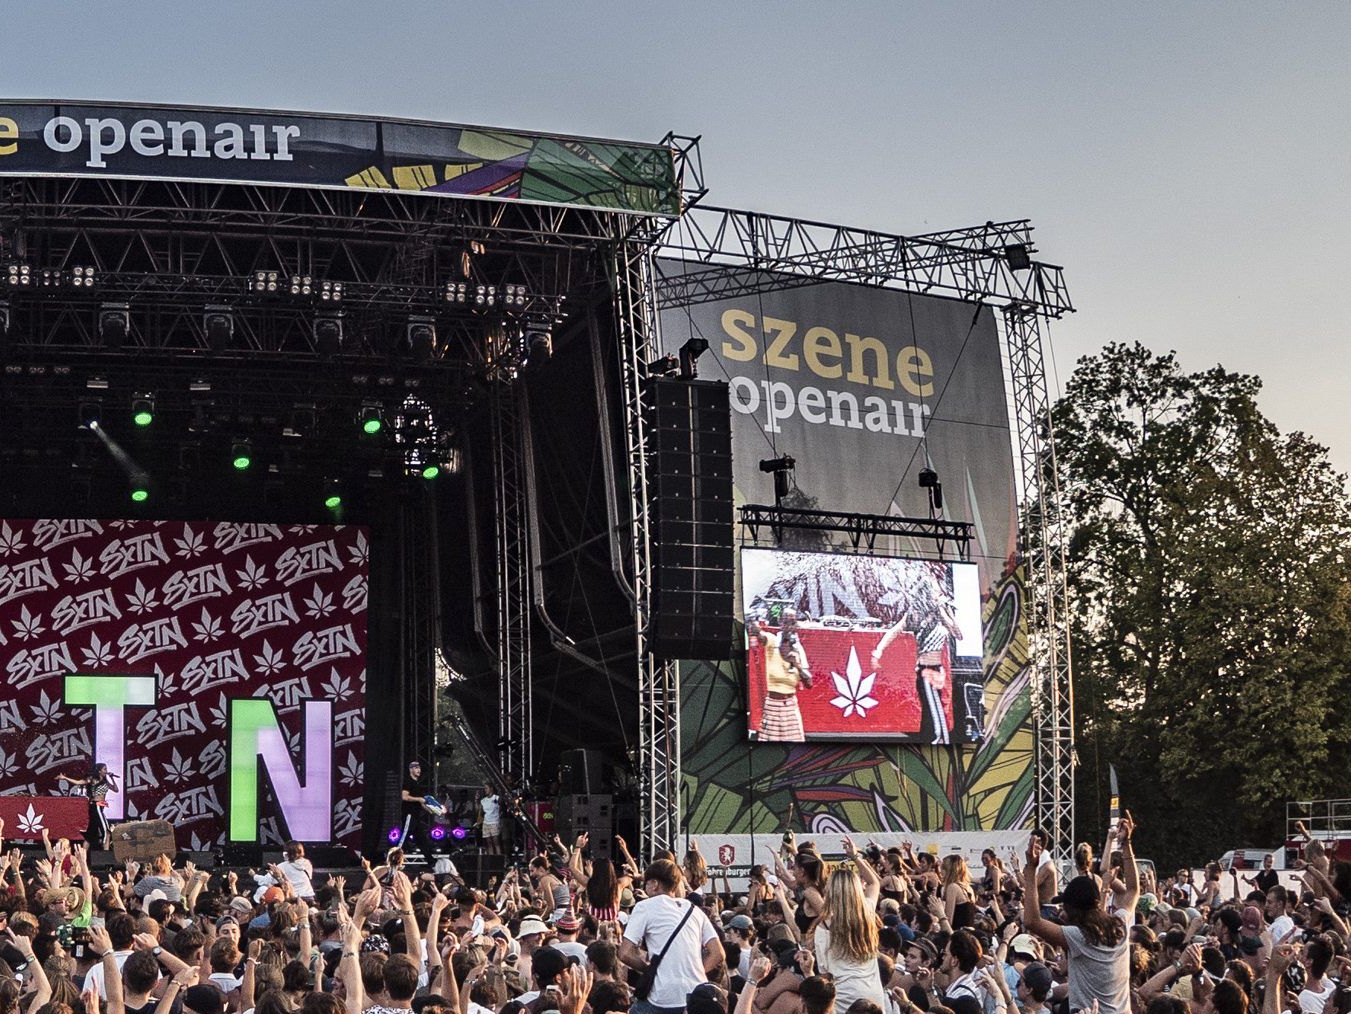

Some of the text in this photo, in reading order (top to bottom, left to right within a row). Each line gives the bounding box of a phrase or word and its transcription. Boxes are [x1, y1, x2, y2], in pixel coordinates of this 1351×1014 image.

[43, 116, 301, 167] openair
[721, 309, 935, 397] szene
[728, 376, 931, 438] openair
